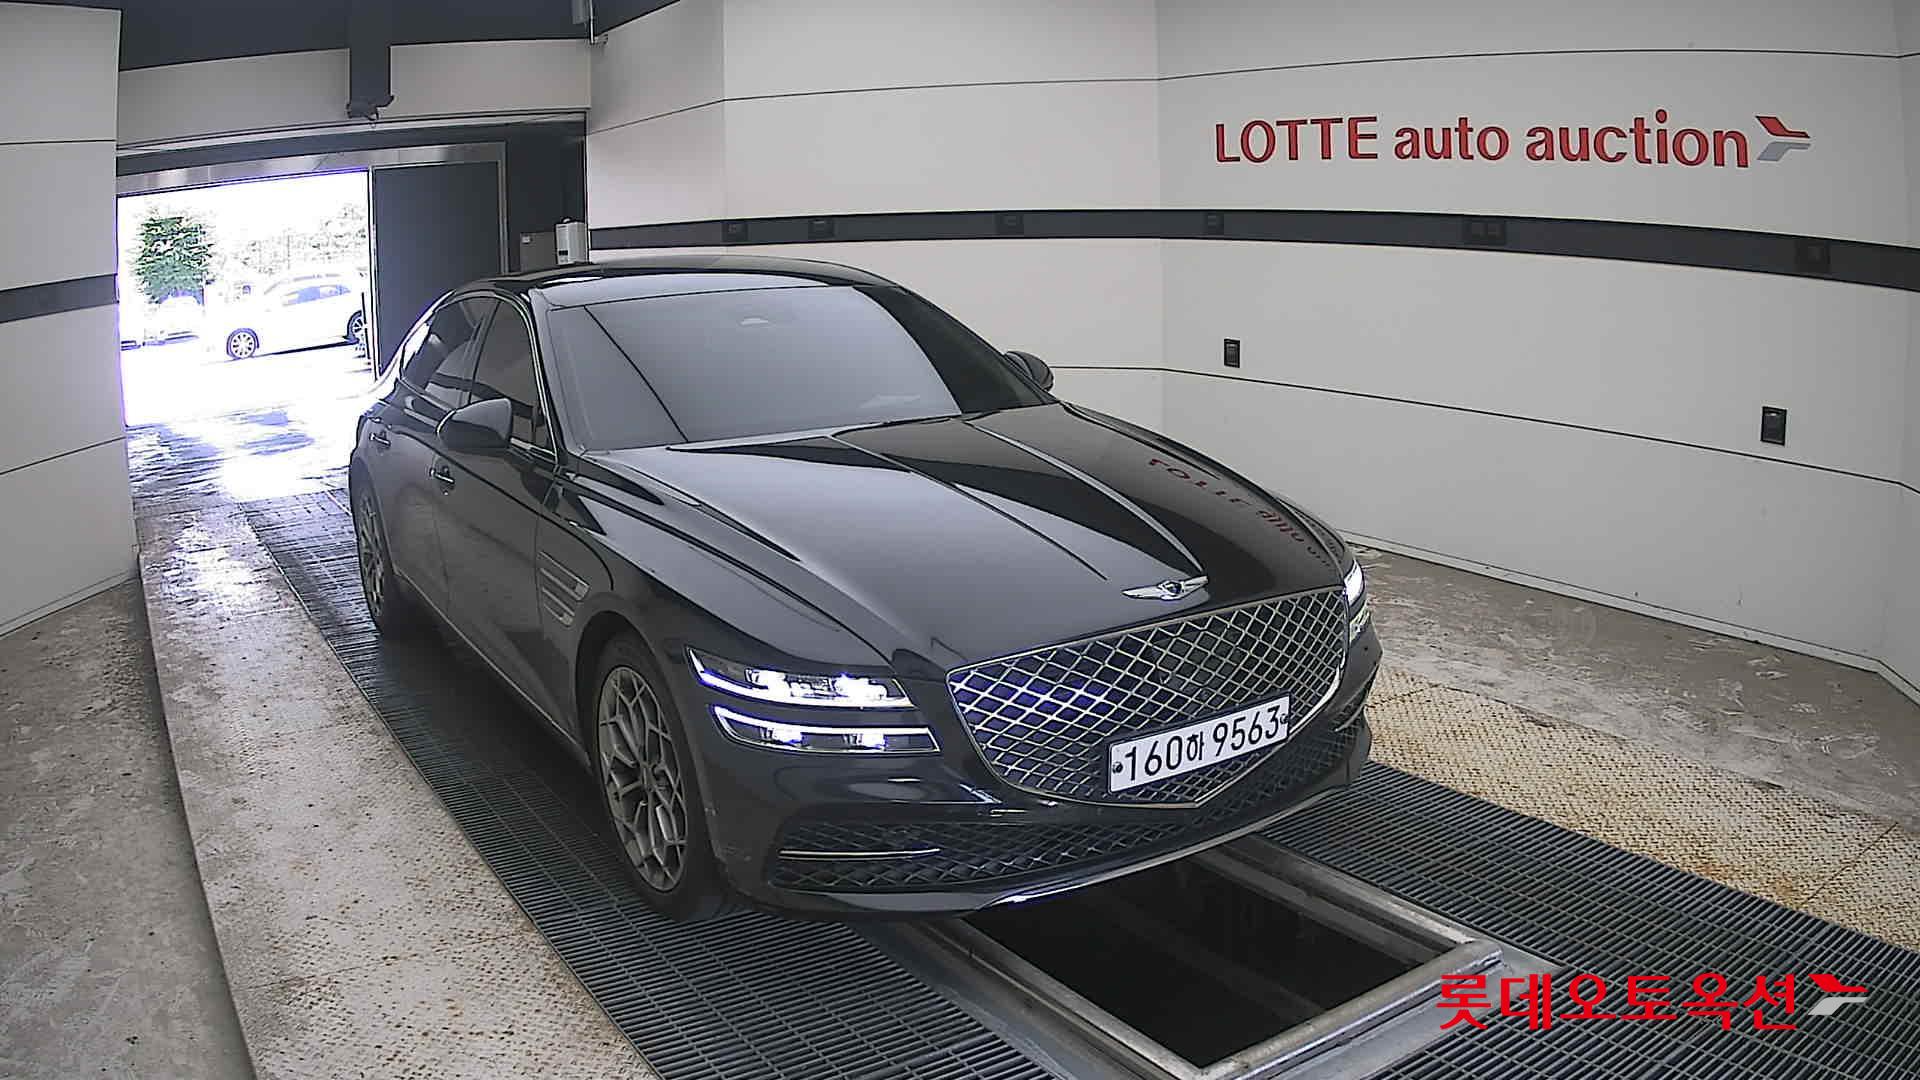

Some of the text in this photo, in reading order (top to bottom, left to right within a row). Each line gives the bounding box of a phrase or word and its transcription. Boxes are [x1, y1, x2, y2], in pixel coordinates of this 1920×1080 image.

[1215, 110, 1751, 168] LOTTE auto auction
[1125, 704, 1281, 781] 160하 9563
